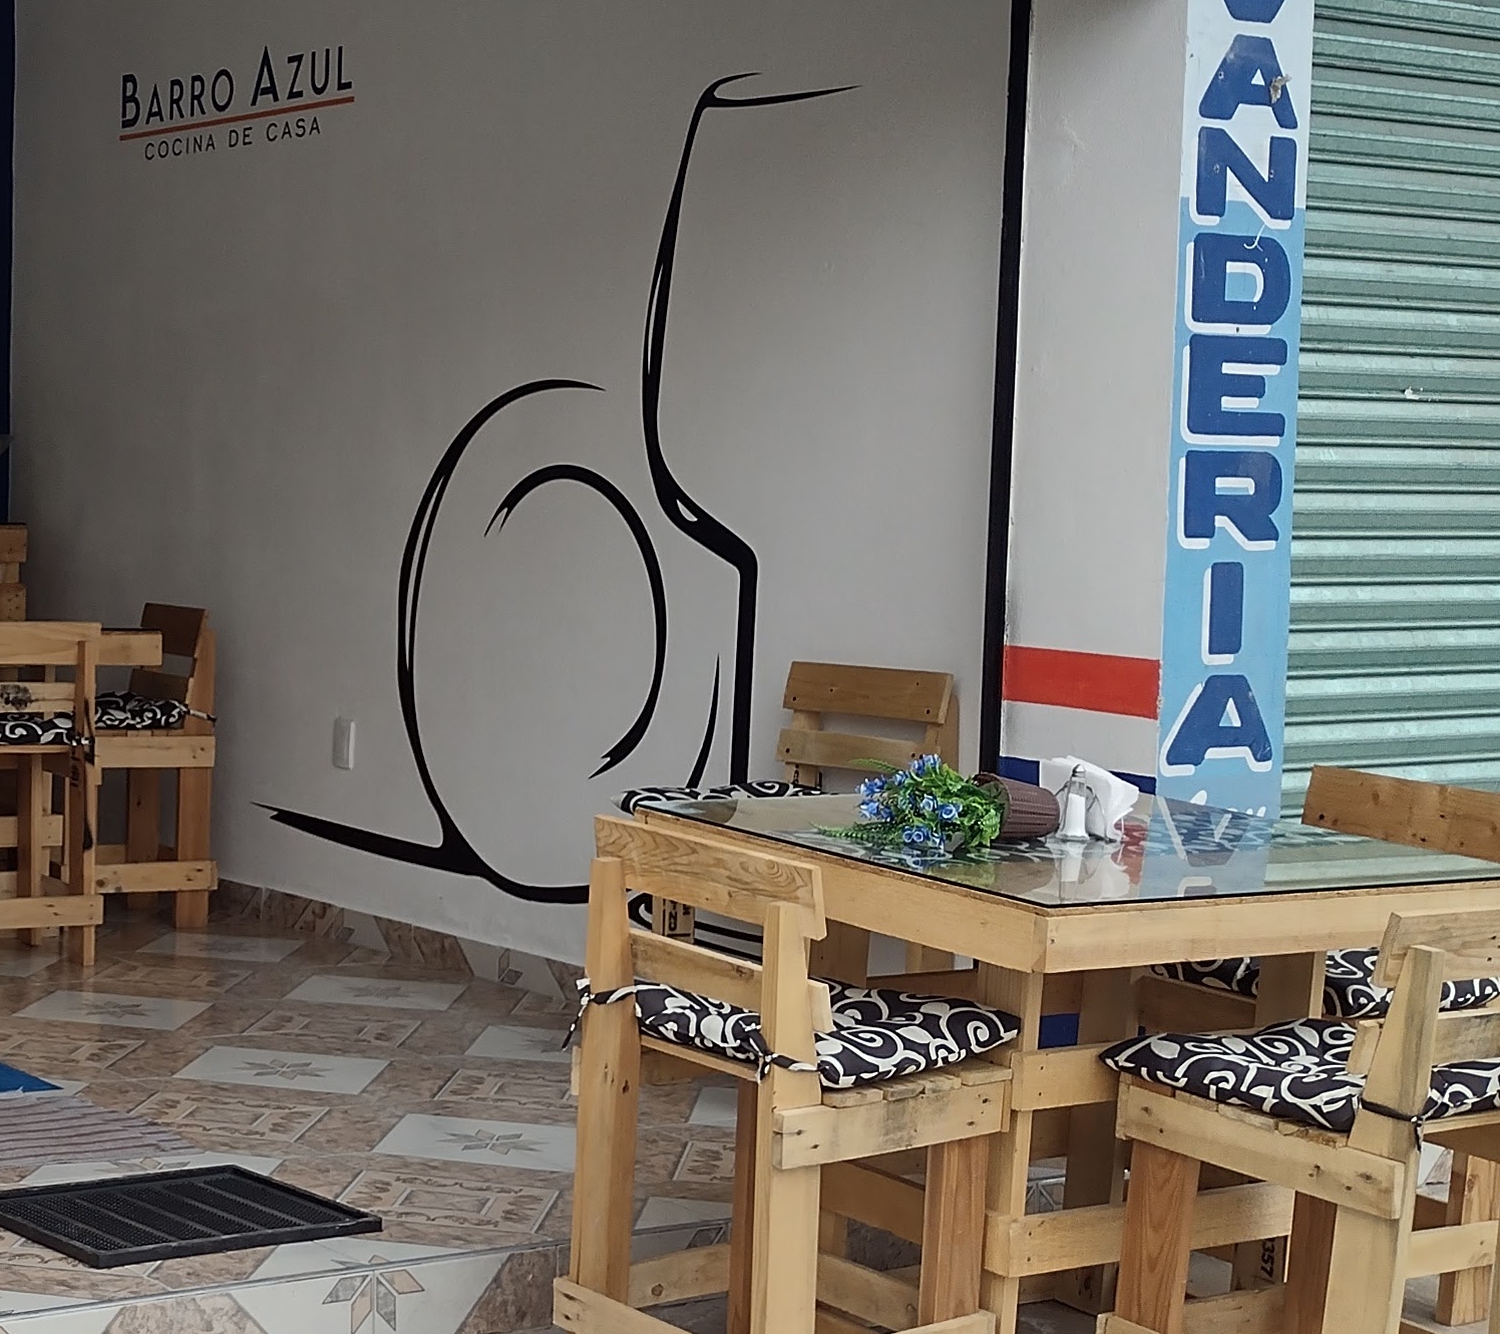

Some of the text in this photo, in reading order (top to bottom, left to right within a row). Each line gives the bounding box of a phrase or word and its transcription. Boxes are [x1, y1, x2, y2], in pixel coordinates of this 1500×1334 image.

[121, 45, 352, 129] BARRO AZUL
[145, 117, 320, 161] COCINA DE CASA
